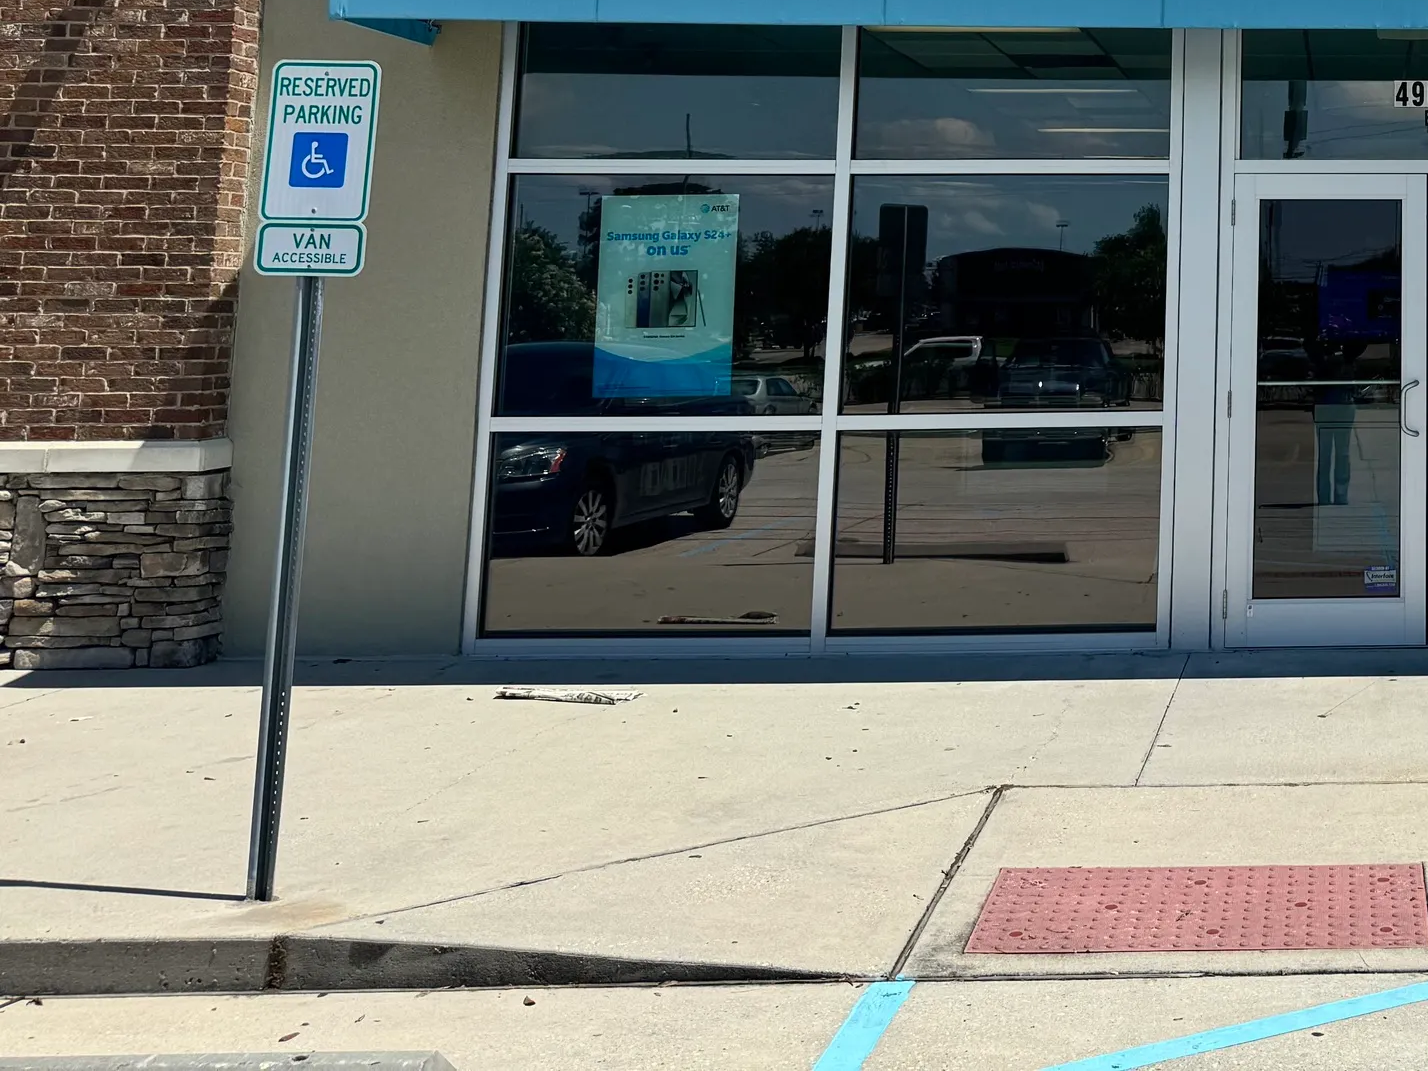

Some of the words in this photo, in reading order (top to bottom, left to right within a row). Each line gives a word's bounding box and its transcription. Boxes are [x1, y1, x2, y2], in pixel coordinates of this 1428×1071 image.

[279, 76, 371, 98] RESERVED
[283, 104, 363, 125] PARKING
[710, 204, 730, 212] AT&T
[292, 232, 332, 250] VAN
[607, 231, 660, 243] Samsung
[661, 230, 702, 243] Galaxy
[703, 229, 732, 241] S24+
[272, 252, 347, 264] ACCESSIBLE
[646, 245, 667, 257] on
